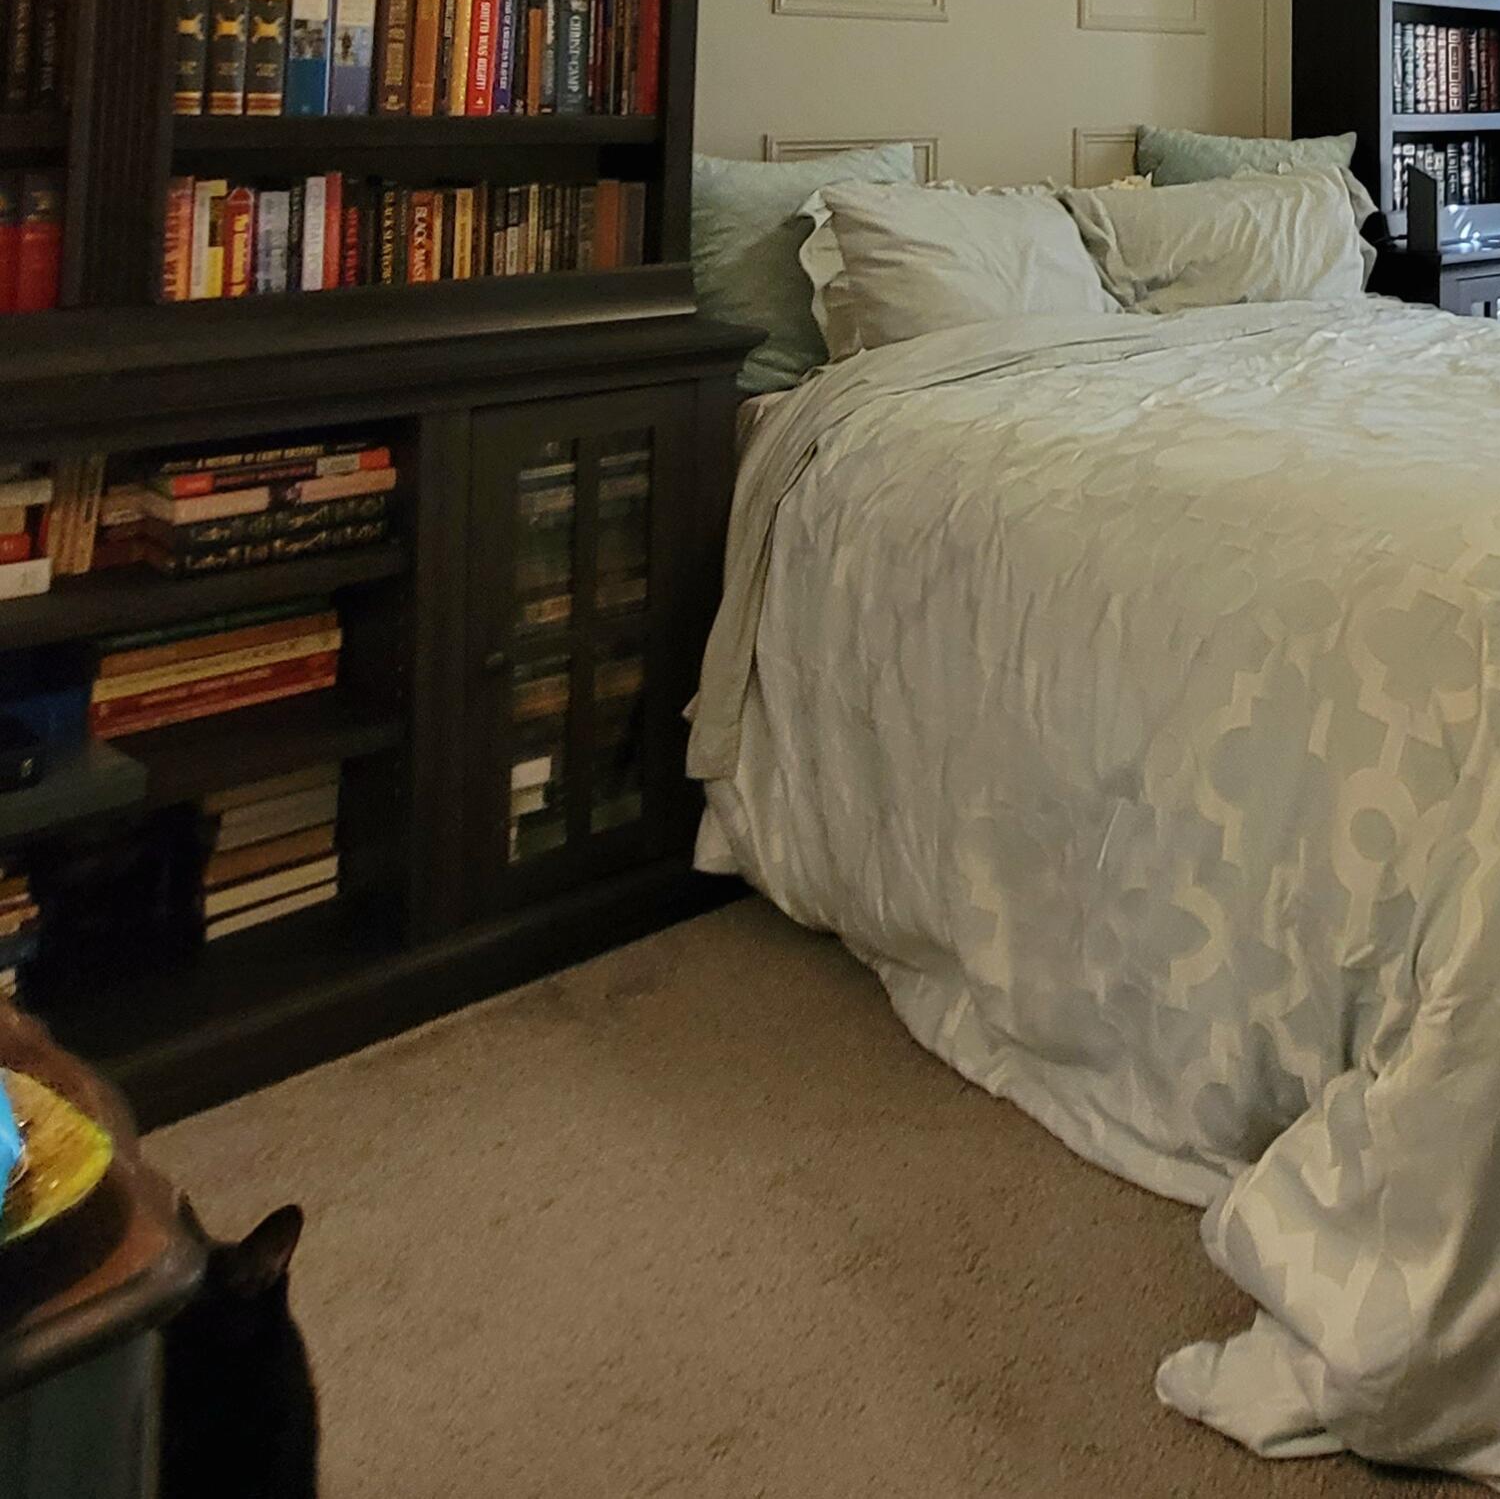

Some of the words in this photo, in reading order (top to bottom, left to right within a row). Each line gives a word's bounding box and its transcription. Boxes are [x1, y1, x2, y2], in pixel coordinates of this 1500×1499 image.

[479, 1, 491, 34] SOUTH
[503, 14, 512, 26] OF
[568, 14, 583, 55] CHRIST
[477, 35, 489, 57] WAS
[475, 57, 487, 91] RIGHT!
[567, 59, 580, 93] CAMP
[383, 191, 396, 228] BLACK
[414, 205, 428, 246] BLACK
